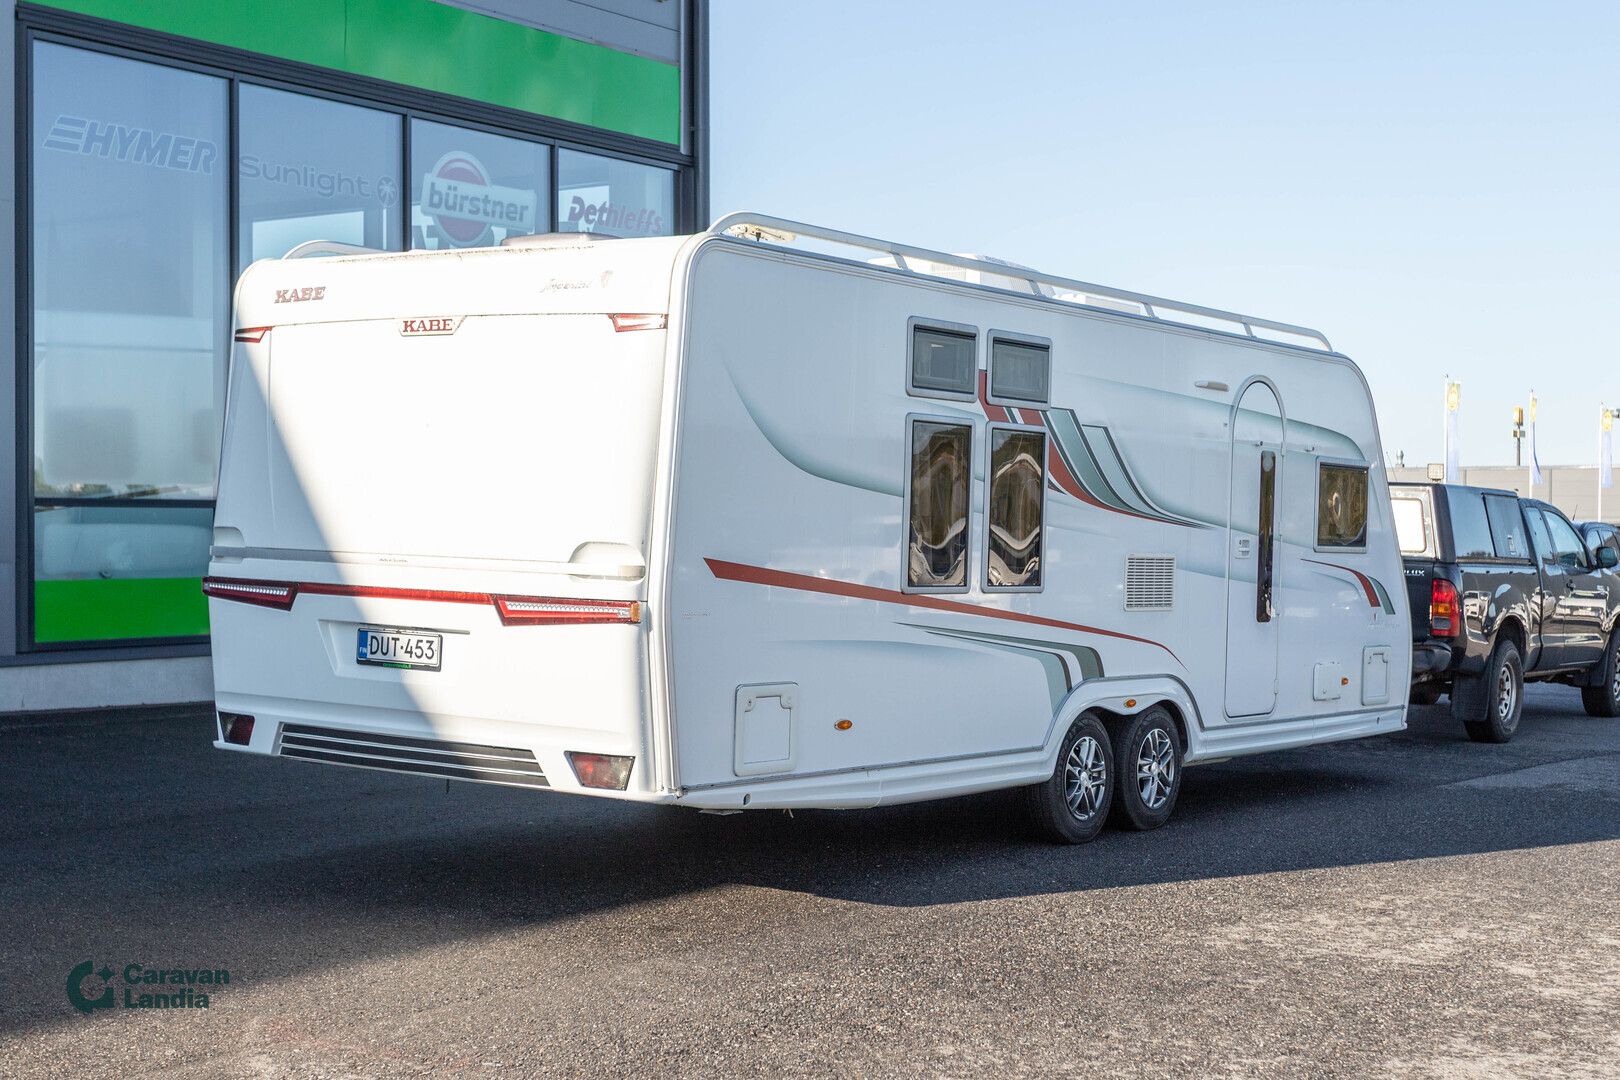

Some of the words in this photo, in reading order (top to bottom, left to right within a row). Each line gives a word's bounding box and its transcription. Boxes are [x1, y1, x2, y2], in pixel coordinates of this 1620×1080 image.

[80, 119, 217, 175] HYMER
[239, 155, 370, 198] Sunlight
[428, 182, 529, 223] bürstner
[568, 195, 663, 234] Dethleffs
[274, 286, 326, 303] KABE
[402, 318, 453, 332] KABE
